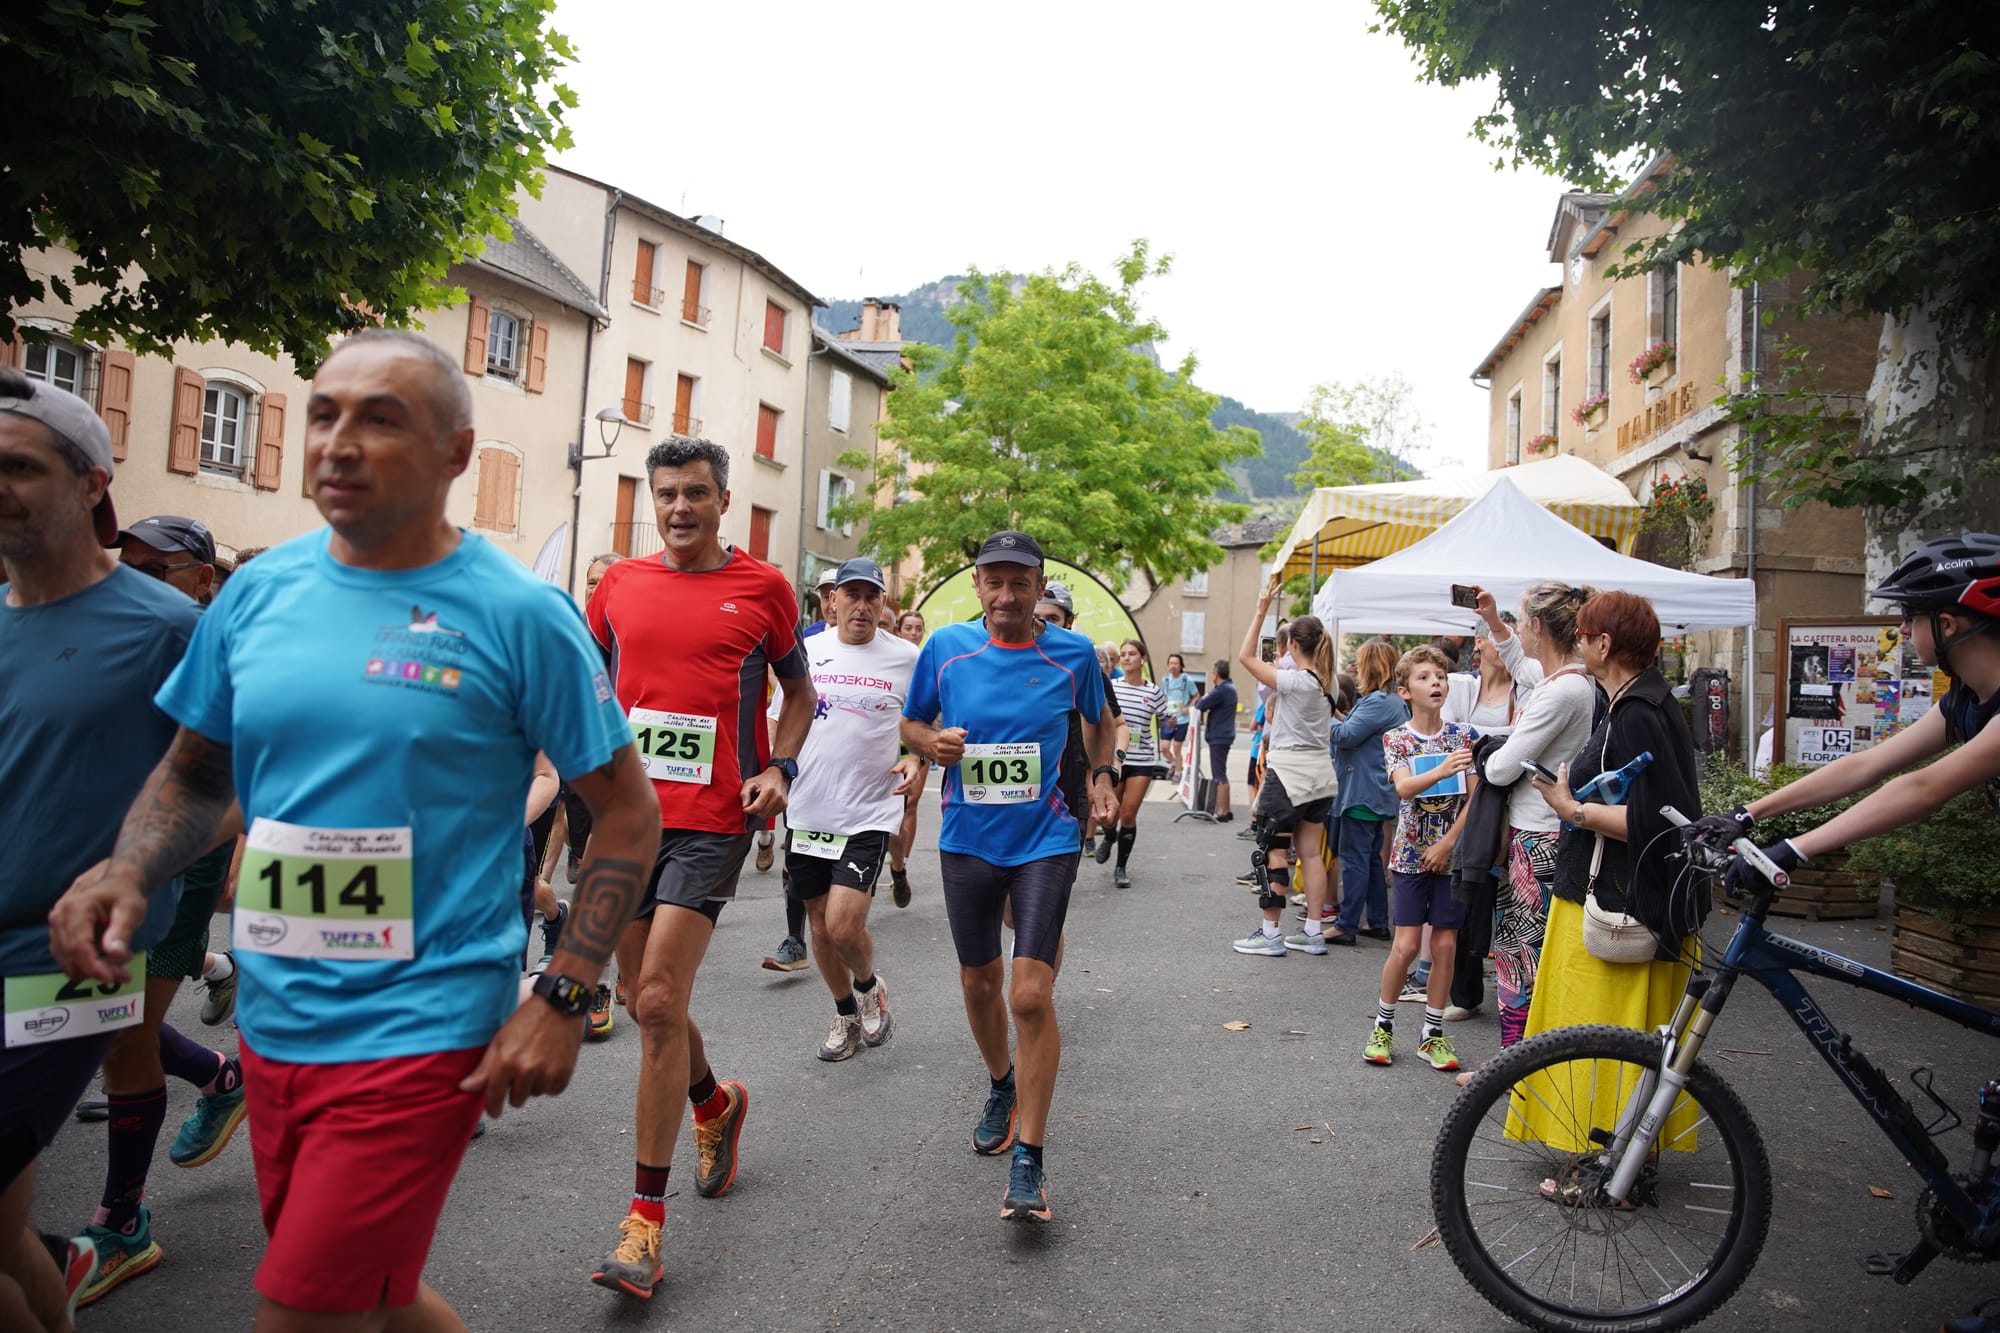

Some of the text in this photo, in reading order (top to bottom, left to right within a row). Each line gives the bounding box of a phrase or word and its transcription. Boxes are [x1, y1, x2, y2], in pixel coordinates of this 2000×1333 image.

[1617, 381, 1696, 451] MAIRIE
[1945, 559, 1974, 570] cairn
[1791, 635, 1876, 643] LA CAFETERA ROJA
[812, 674, 893, 692] MENDEKIDEN
[666, 714, 697, 724] Challenge
[1813, 719, 1845, 728] MOZAIK
[638, 727, 701, 760] 125
[1824, 731, 1850, 747] 05
[1802, 753, 1845, 762] FLORA
[665, 765, 694, 774] TUFF'S
[971, 759, 1029, 784] 103
[259, 858, 385, 916] 114
[320, 929, 377, 943] TUFF'S
[24, 1016, 64, 1031] BFP
[97, 1004, 129, 1018] TUFF'S
[98, 1250, 129, 1278] HOKA
[1530, 1306, 1663, 1333] SCHWALBE
